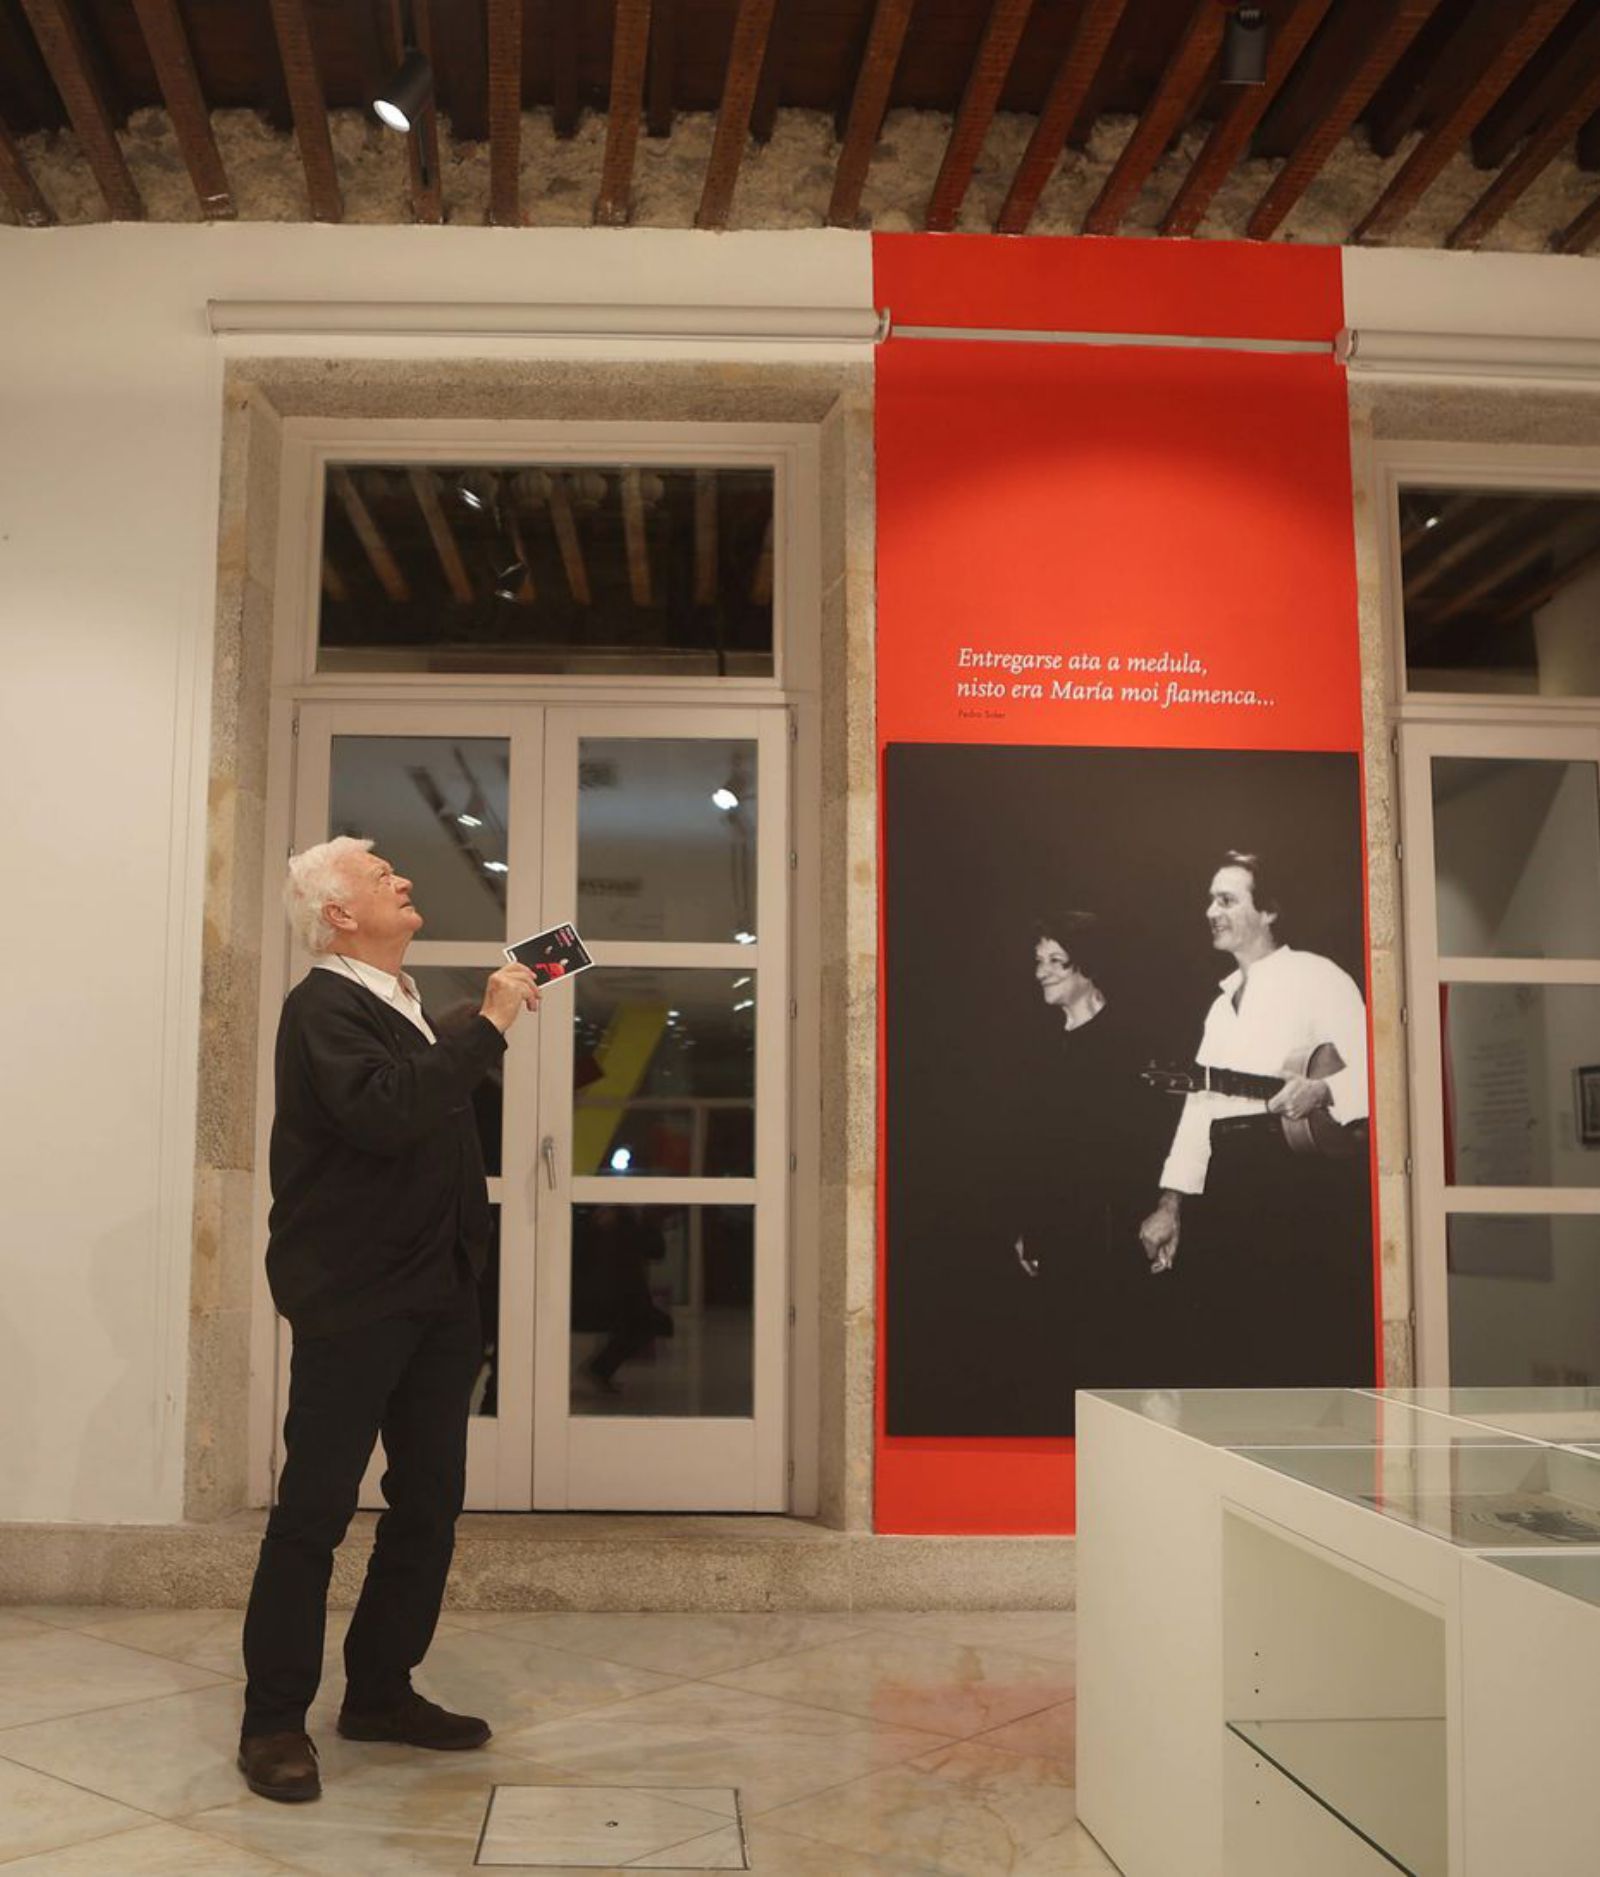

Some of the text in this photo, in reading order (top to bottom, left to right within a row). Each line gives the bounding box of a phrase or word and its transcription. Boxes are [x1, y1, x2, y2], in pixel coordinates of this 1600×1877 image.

[958, 648, 1208, 677] Entregarse ata a medula,
[957, 677, 1275, 709] nisto era María moi flamenca...
